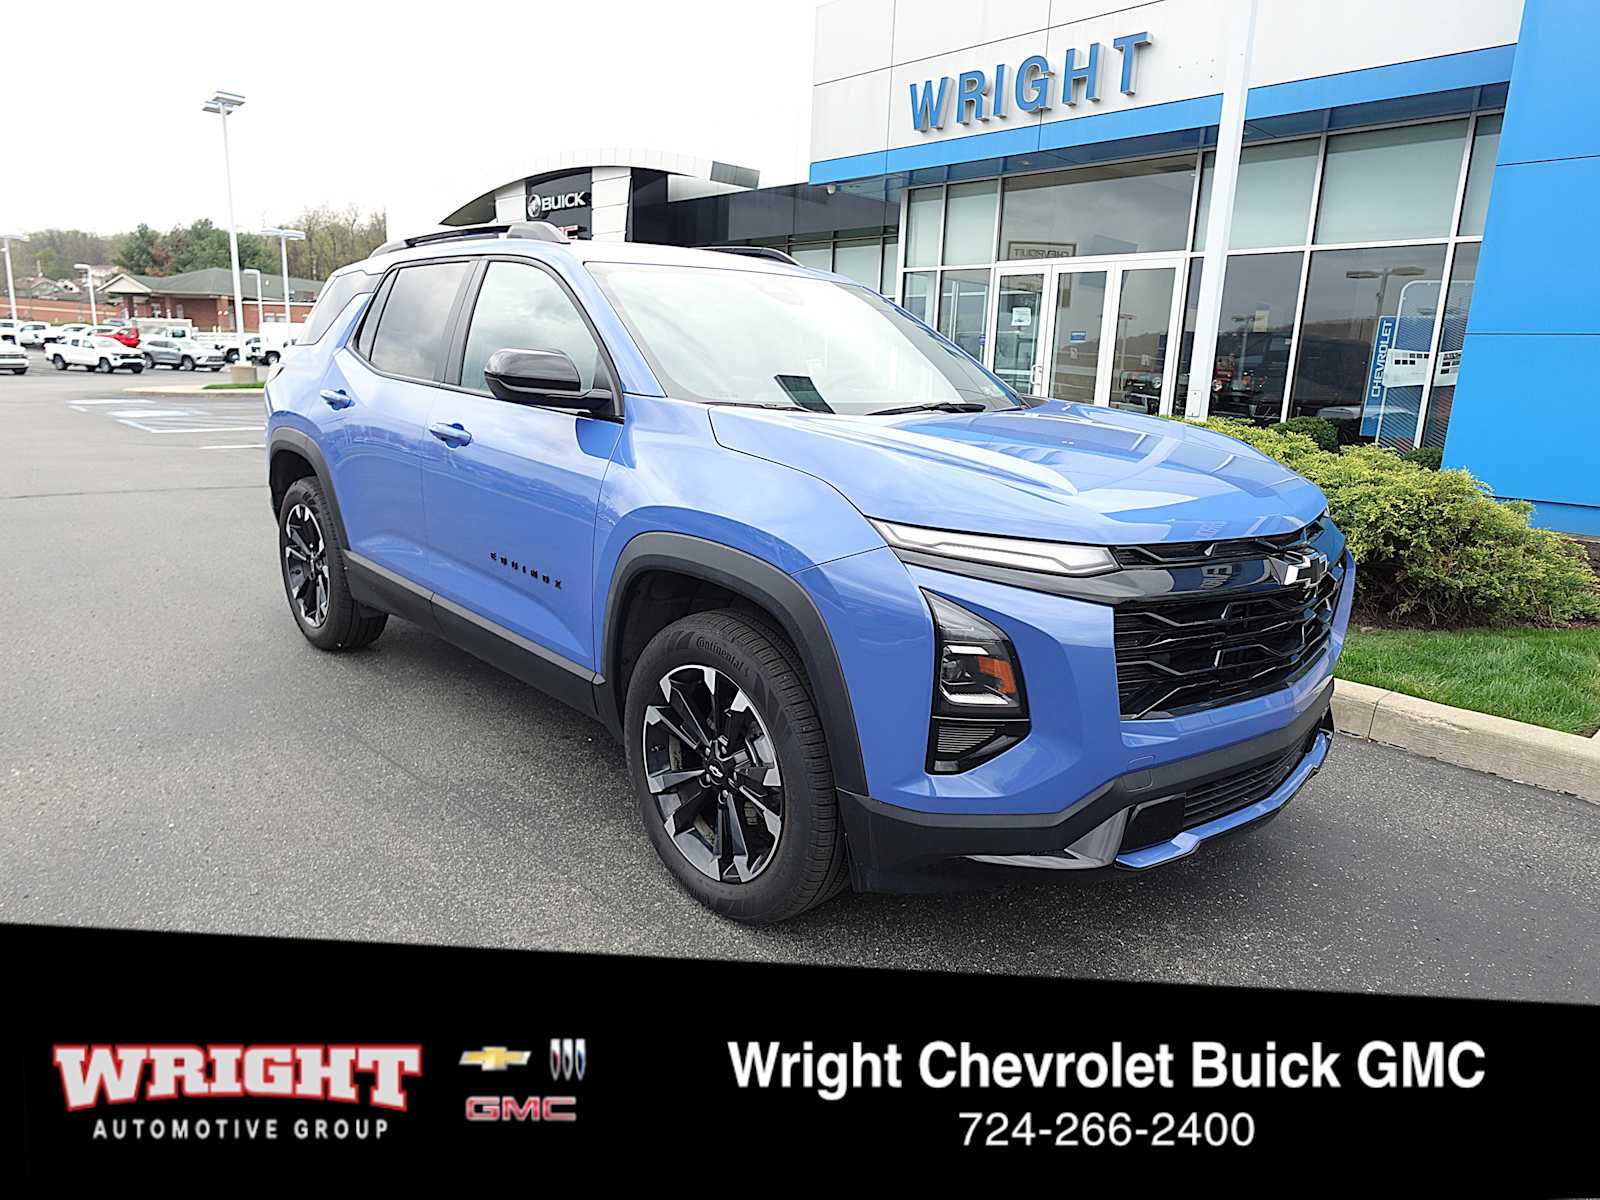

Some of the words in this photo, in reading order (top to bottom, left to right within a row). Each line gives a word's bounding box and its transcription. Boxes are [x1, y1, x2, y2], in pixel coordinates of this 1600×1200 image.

[909, 31, 1153, 132] WRIGHT
[541, 191, 586, 211] BUICK
[1371, 320, 1393, 398] CHEVROLET
[696, 636, 745, 671] Continental
